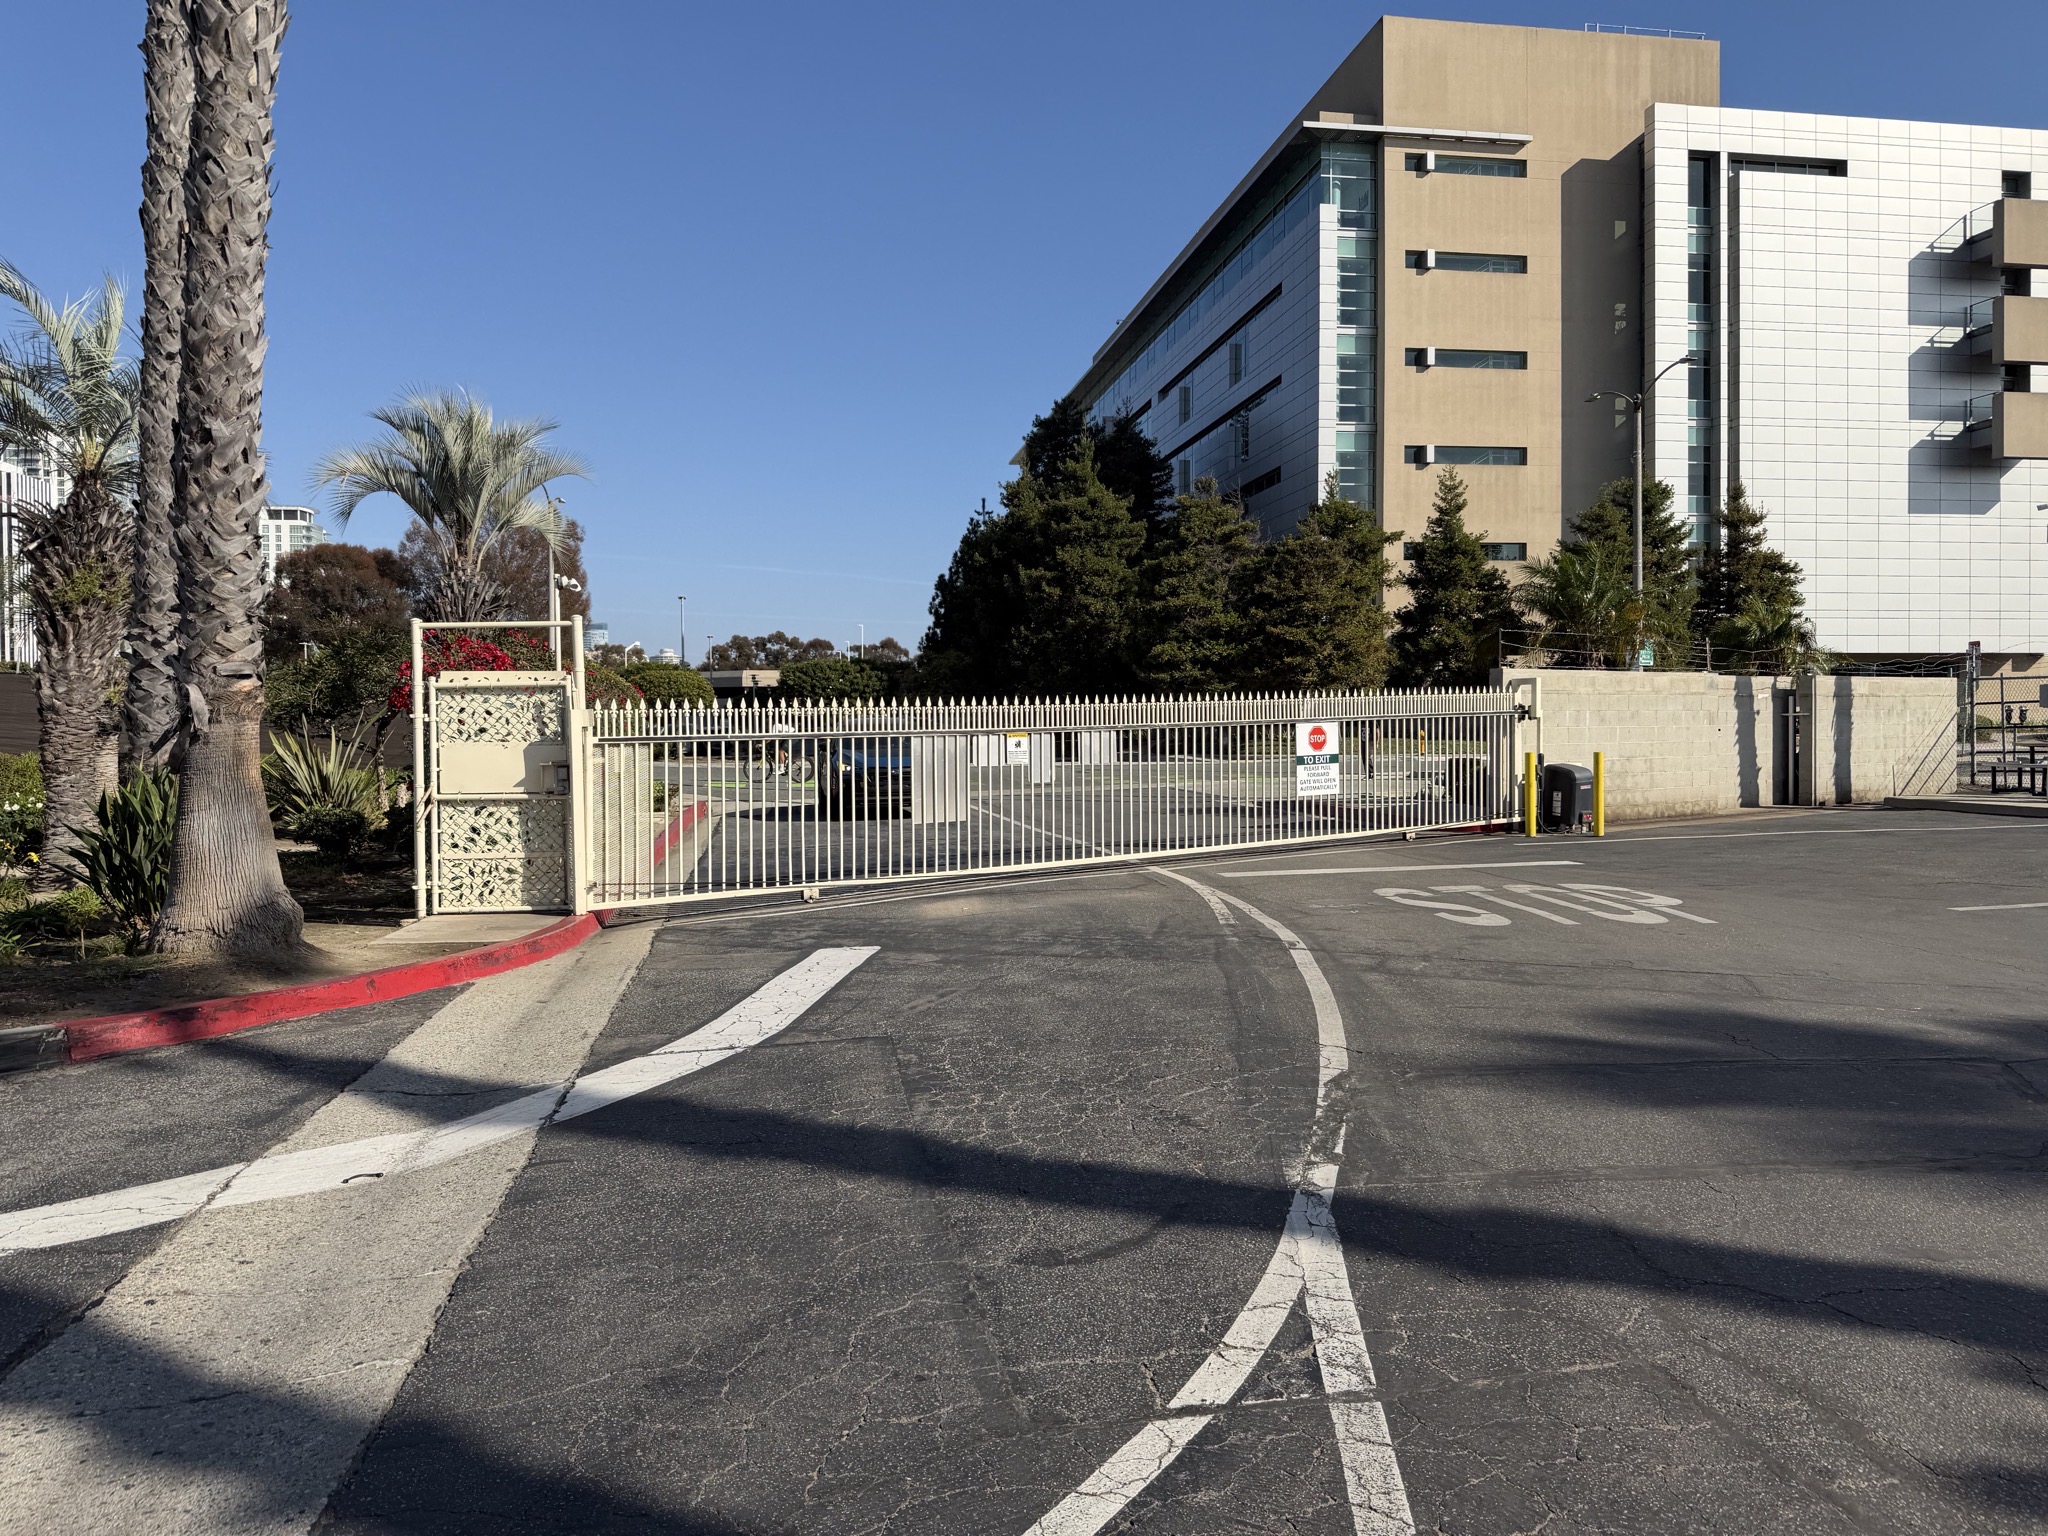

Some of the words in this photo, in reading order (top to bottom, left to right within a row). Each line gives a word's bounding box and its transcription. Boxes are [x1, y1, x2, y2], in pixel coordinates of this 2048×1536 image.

[1303, 756, 1313, 764] TO
[1315, 755, 1330, 763] EXIT
[1373, 883, 1719, 926] STOP
